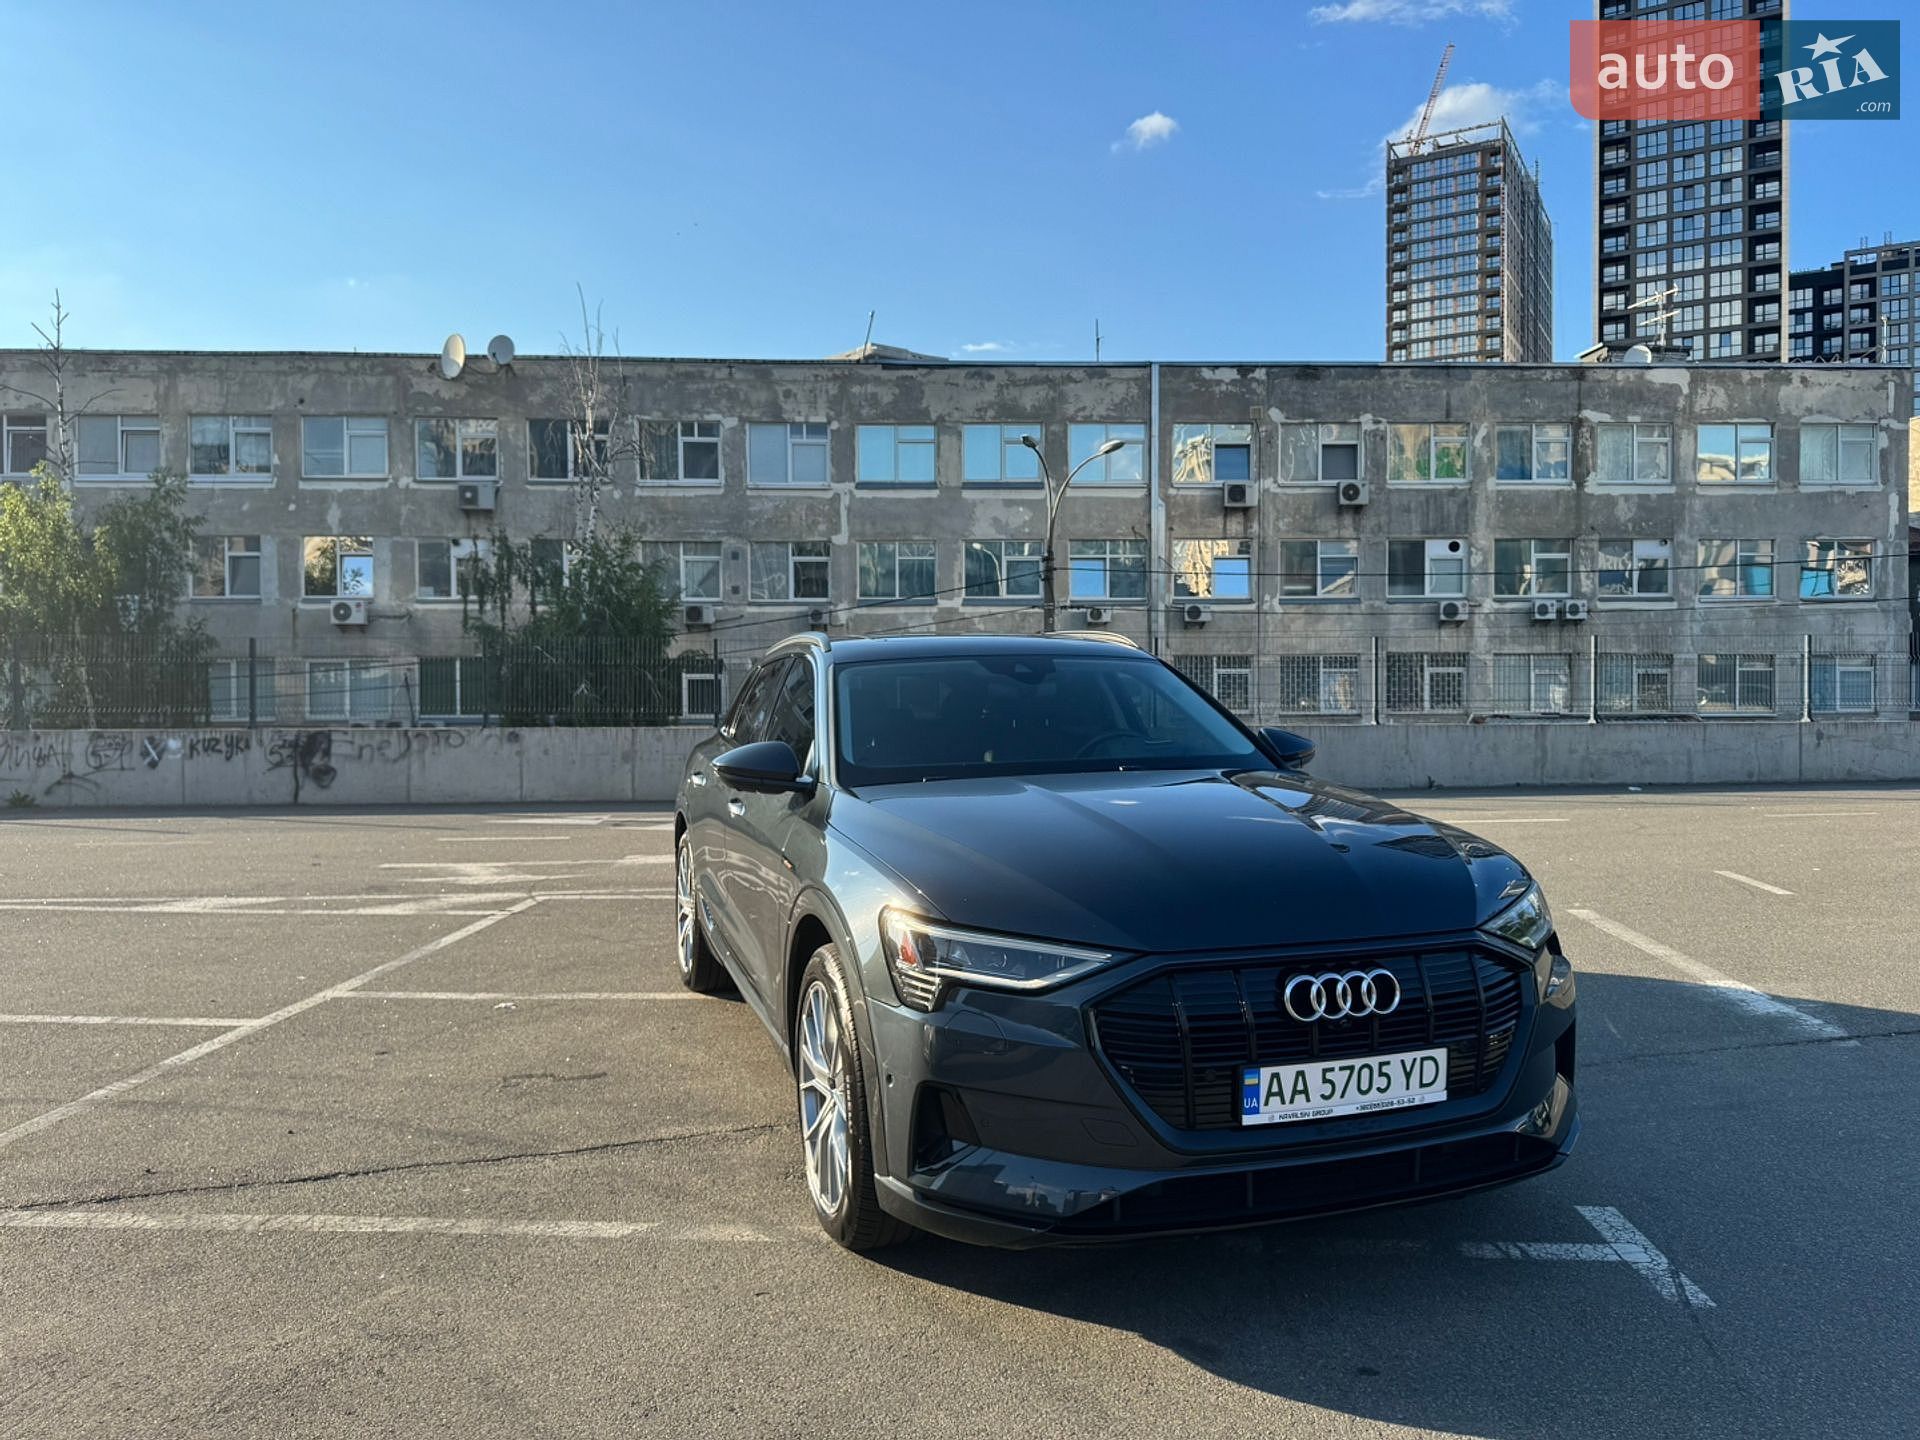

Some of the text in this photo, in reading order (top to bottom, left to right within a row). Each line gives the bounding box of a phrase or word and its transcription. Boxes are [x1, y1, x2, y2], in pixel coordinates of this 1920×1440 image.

[1263, 1055, 1440, 1107] AA 5705 YD
[1244, 1097, 1258, 1109] UA
